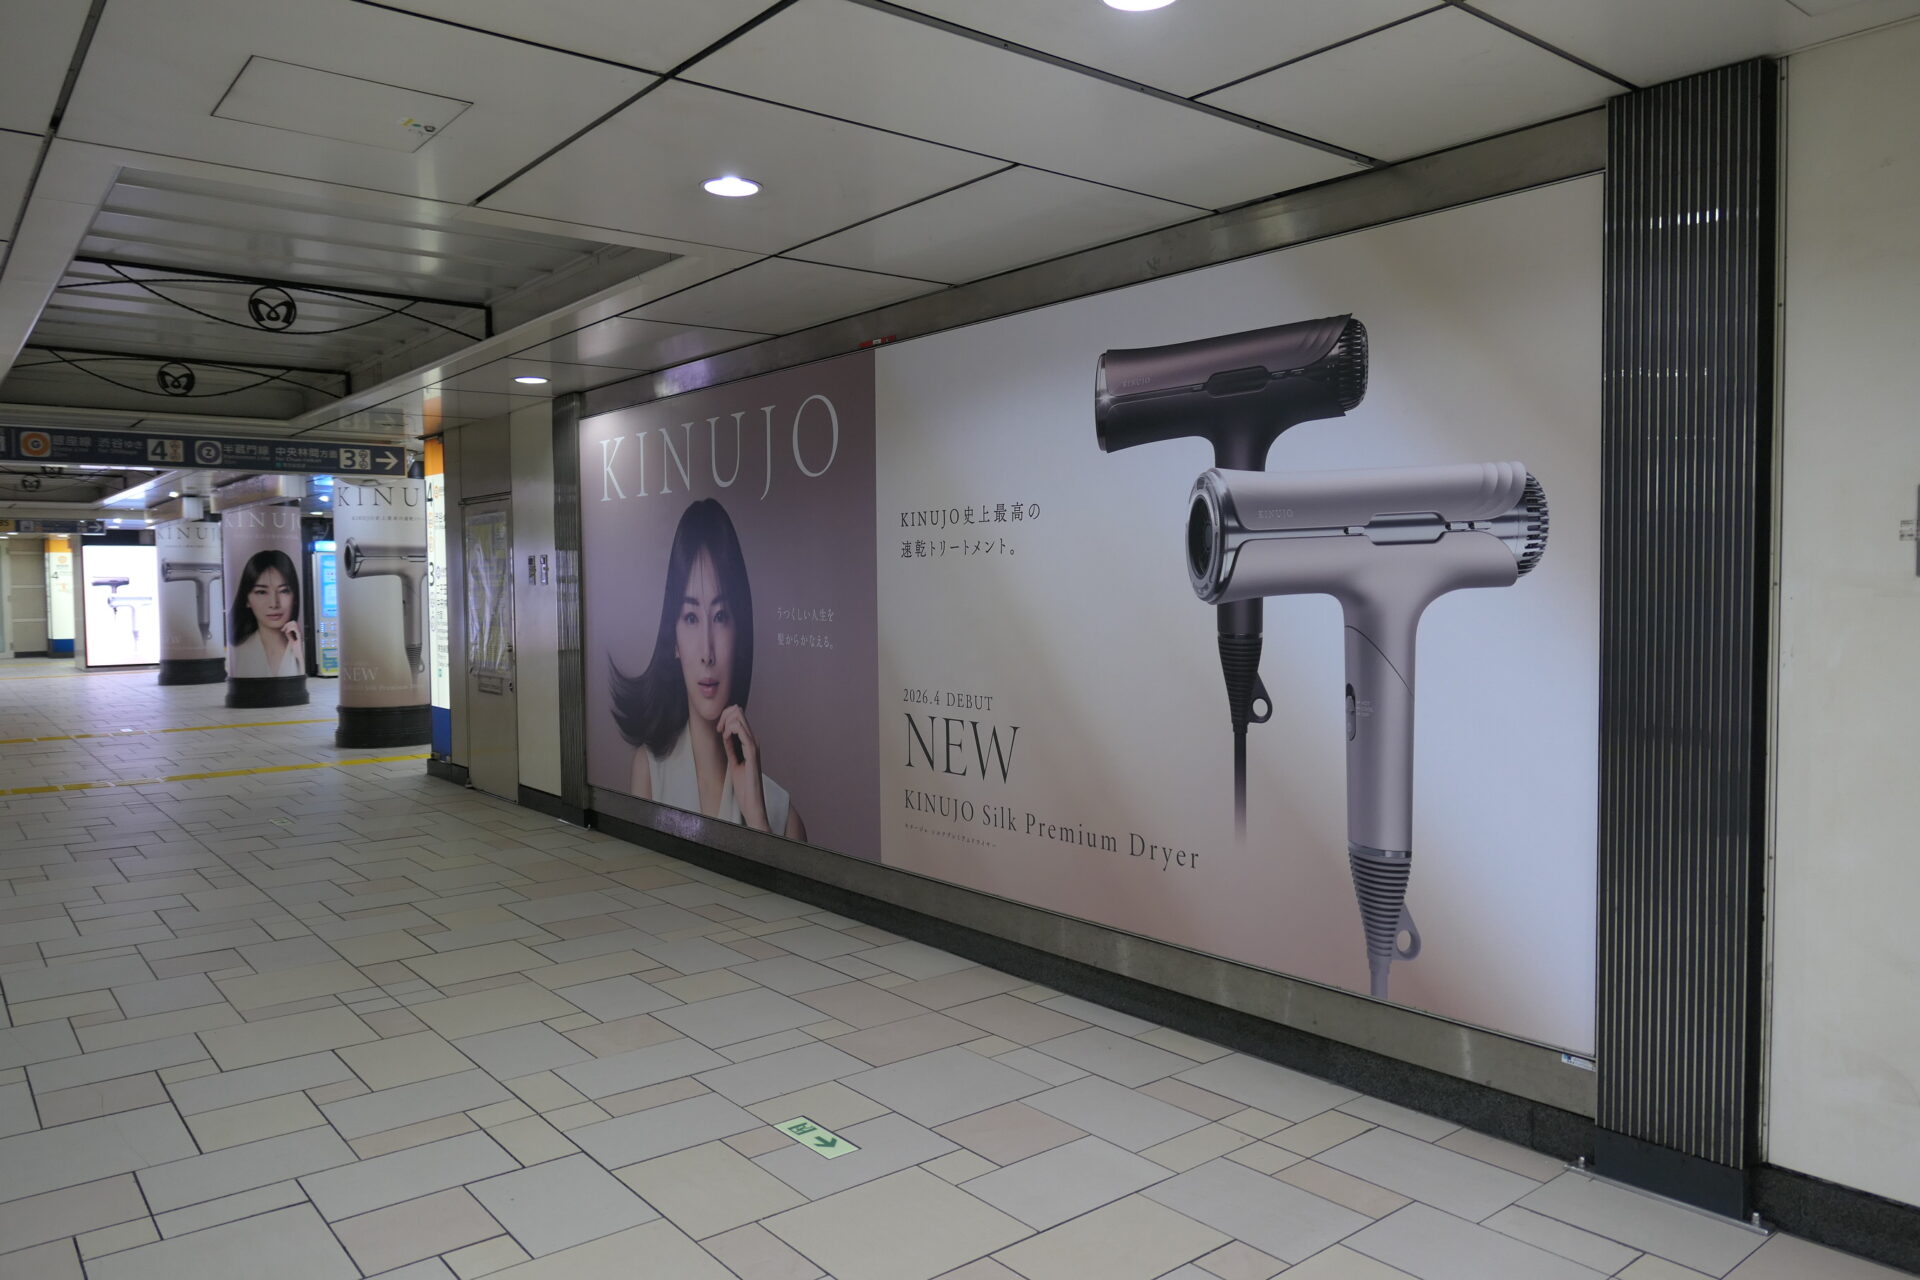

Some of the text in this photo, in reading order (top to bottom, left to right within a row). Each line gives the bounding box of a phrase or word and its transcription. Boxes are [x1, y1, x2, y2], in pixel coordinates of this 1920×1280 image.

[152, 440, 168, 461] 4
[343, 449, 356, 468] 3
[599, 394, 839, 503] KINUJO
[338, 486, 420, 507] KINU
[900, 502, 1041, 530] KINUJO史上最高の
[901, 538, 1015, 558] 速乾トリートメント。
[903, 688, 993, 711] 2026.4 DEBUT
[904, 712, 1021, 784] NEW
[905, 789, 974, 823] KINUJO
[982, 804, 1017, 832] Silk
[1025, 812, 1118, 852] Premium
[1129, 833, 1199, 872] Dryer
